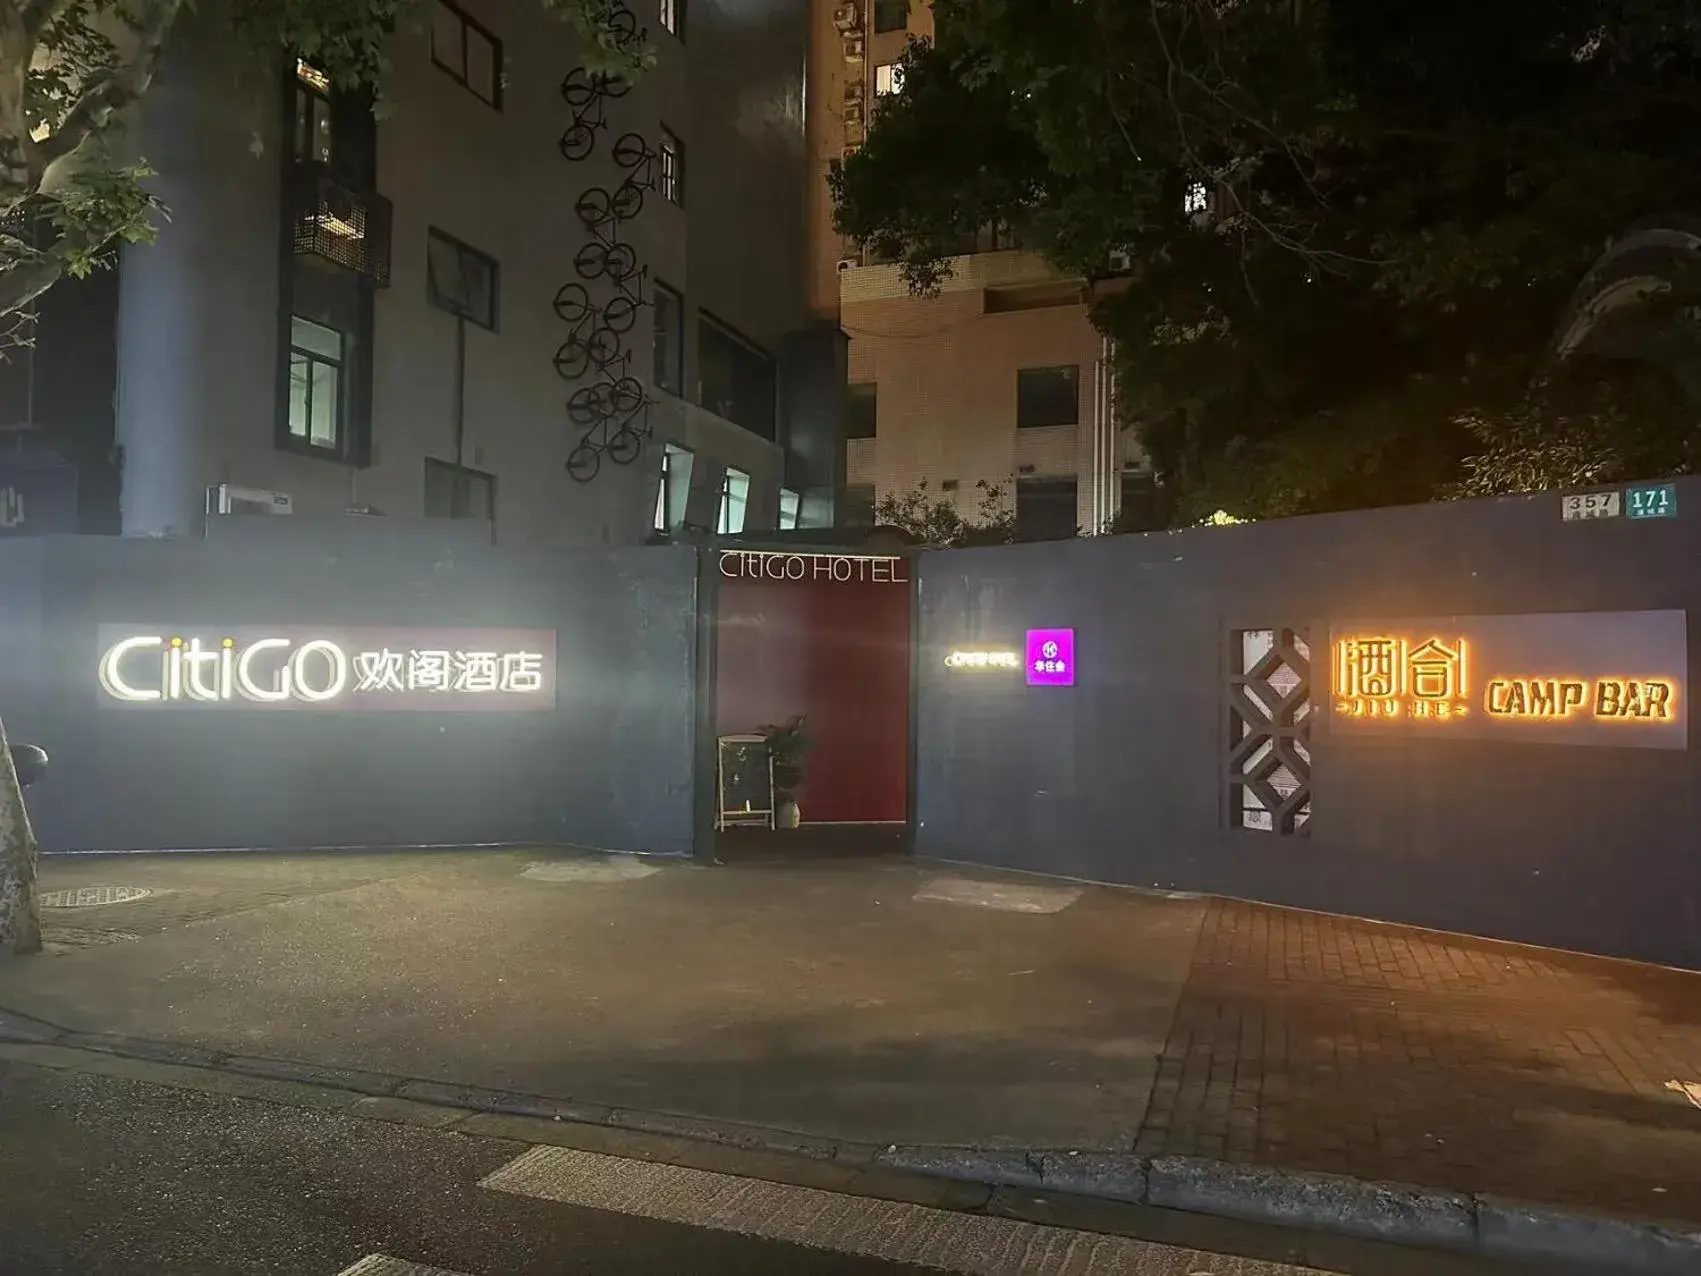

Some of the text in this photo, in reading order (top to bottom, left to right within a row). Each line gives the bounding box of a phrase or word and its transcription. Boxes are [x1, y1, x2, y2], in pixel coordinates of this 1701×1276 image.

[1569, 494, 1612, 510] 357
[1632, 489, 1669, 508] 171
[813, 556, 909, 583] HOTEL
[358, 647, 543, 692] 欢阁酒店
[1487, 680, 1672, 720] CAMP BAR
